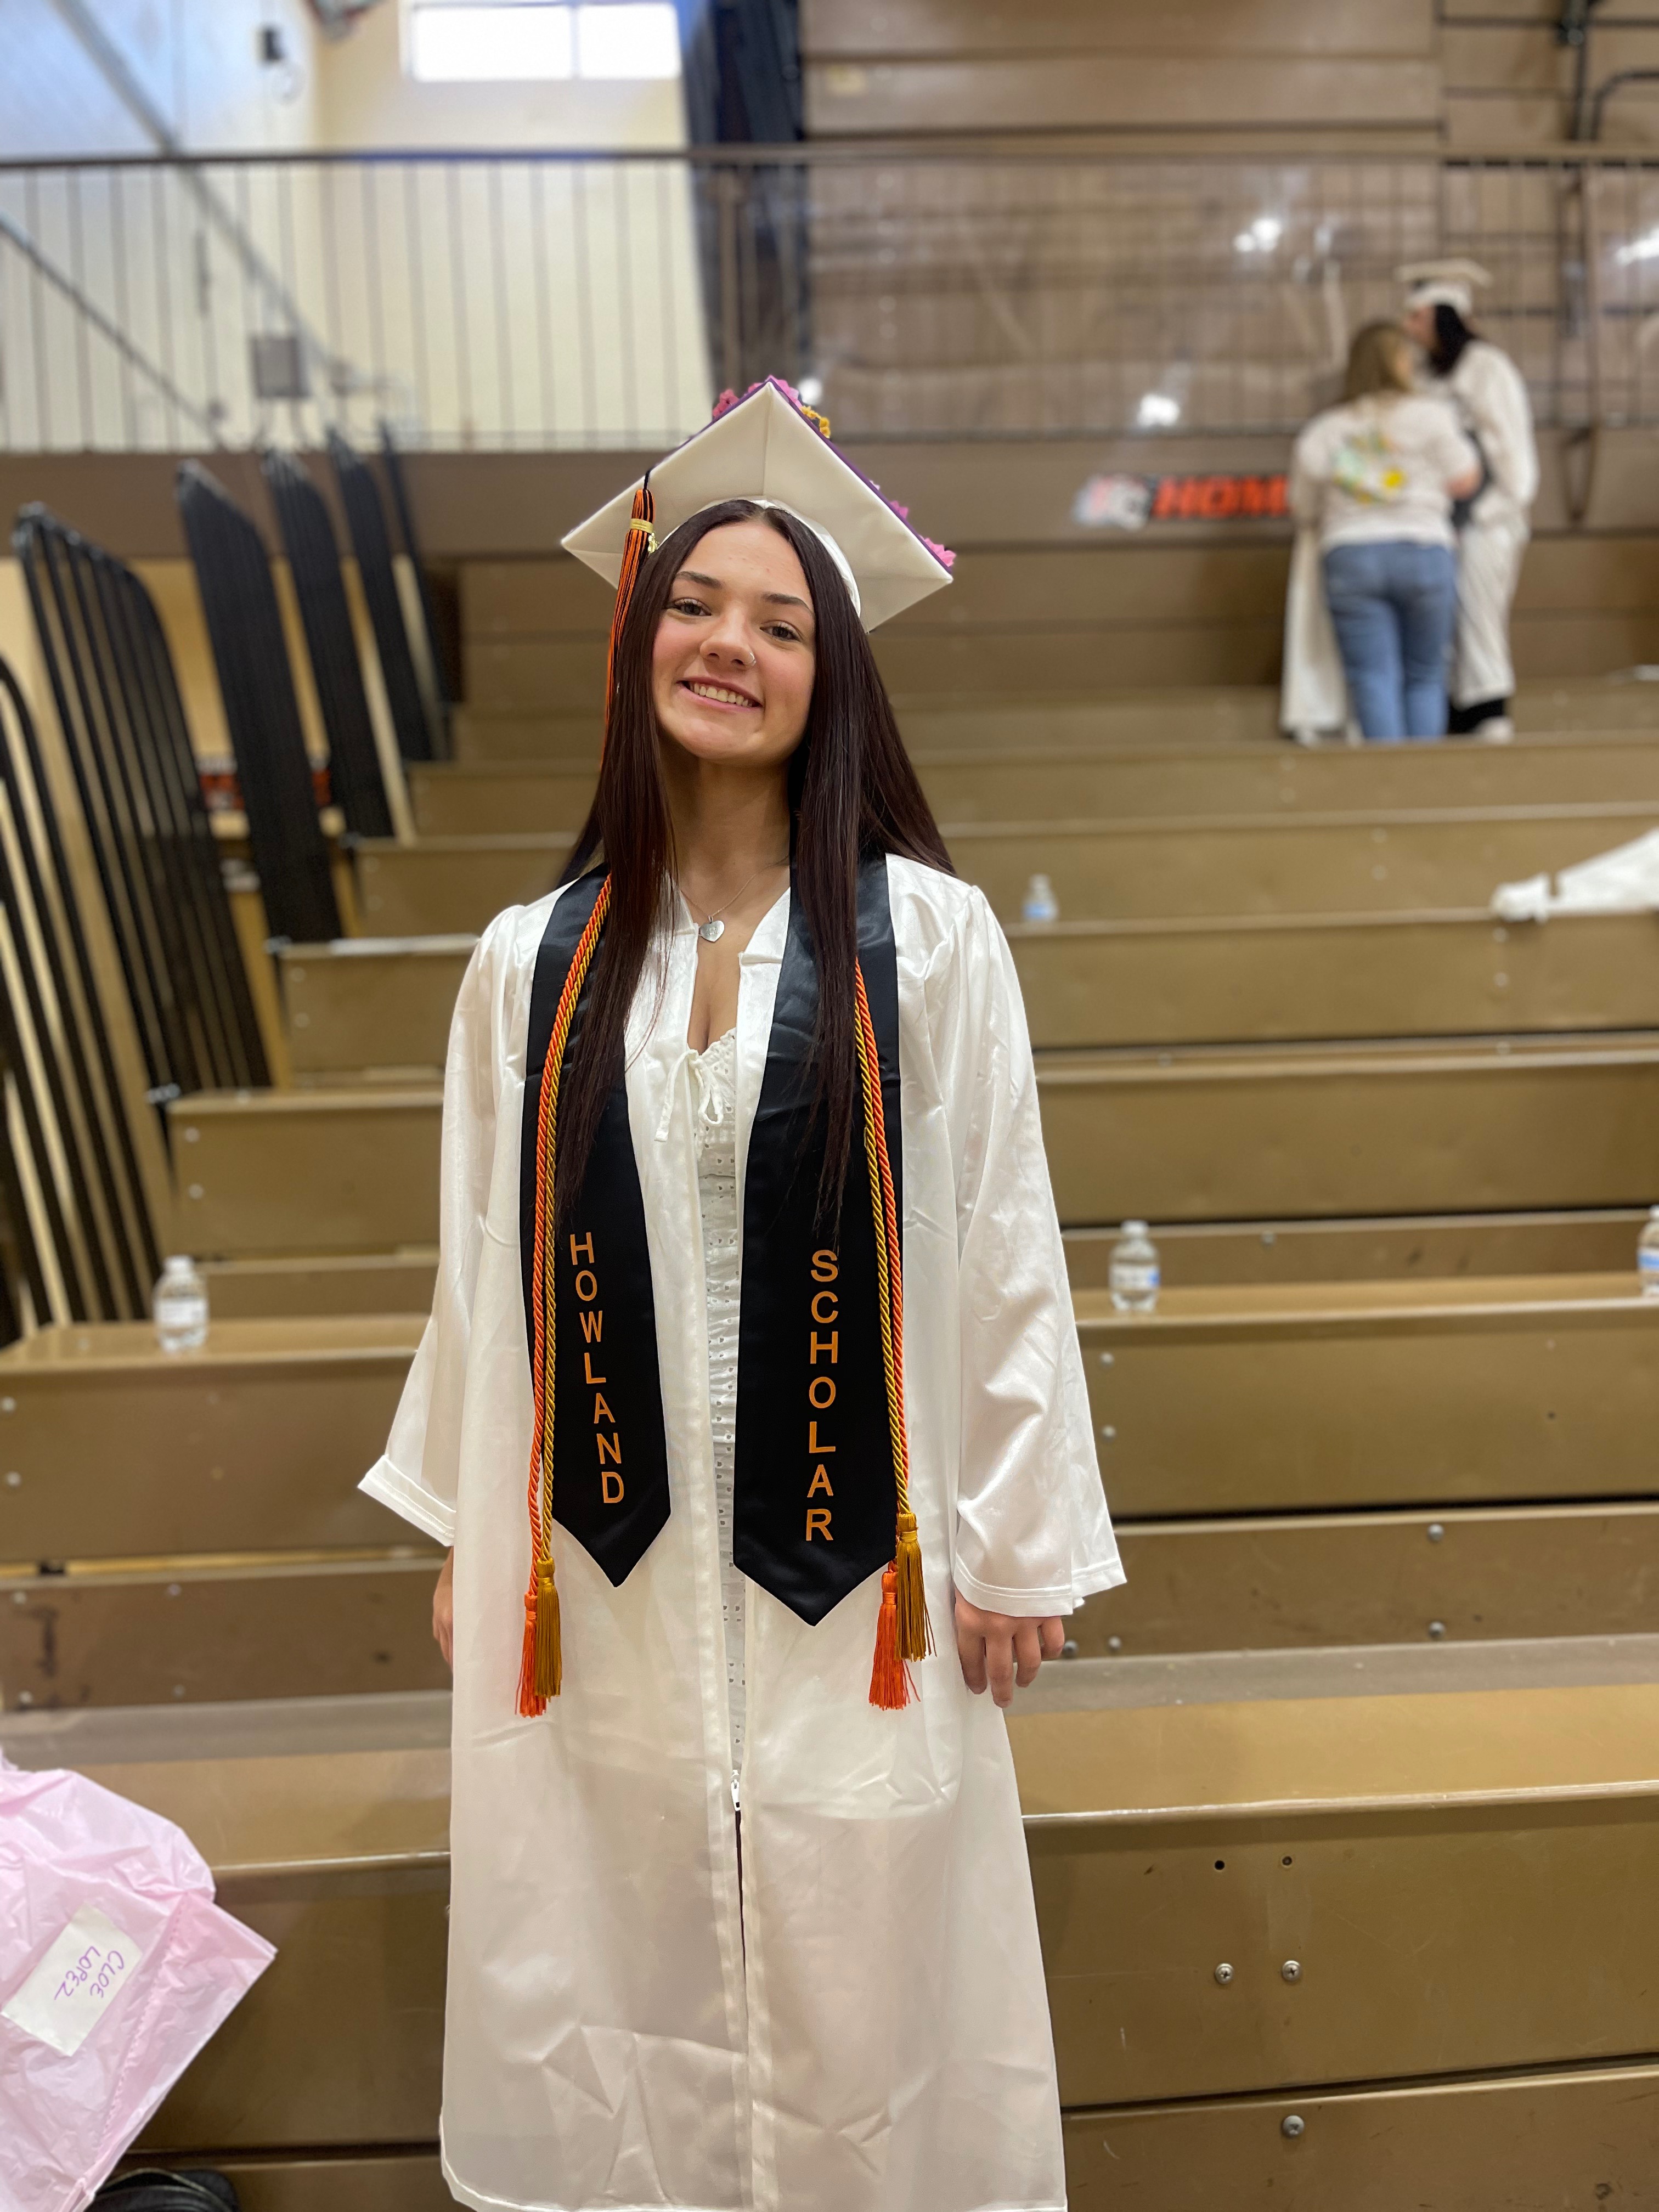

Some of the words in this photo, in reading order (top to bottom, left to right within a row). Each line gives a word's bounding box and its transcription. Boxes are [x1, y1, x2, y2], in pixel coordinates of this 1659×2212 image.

[569, 1232, 624, 1504] HOWLAND
[806, 1249, 839, 1542] SCHOLAR
[54, 1946, 101, 2000] LOPEZ
[90, 1950, 124, 1998] CLOE
